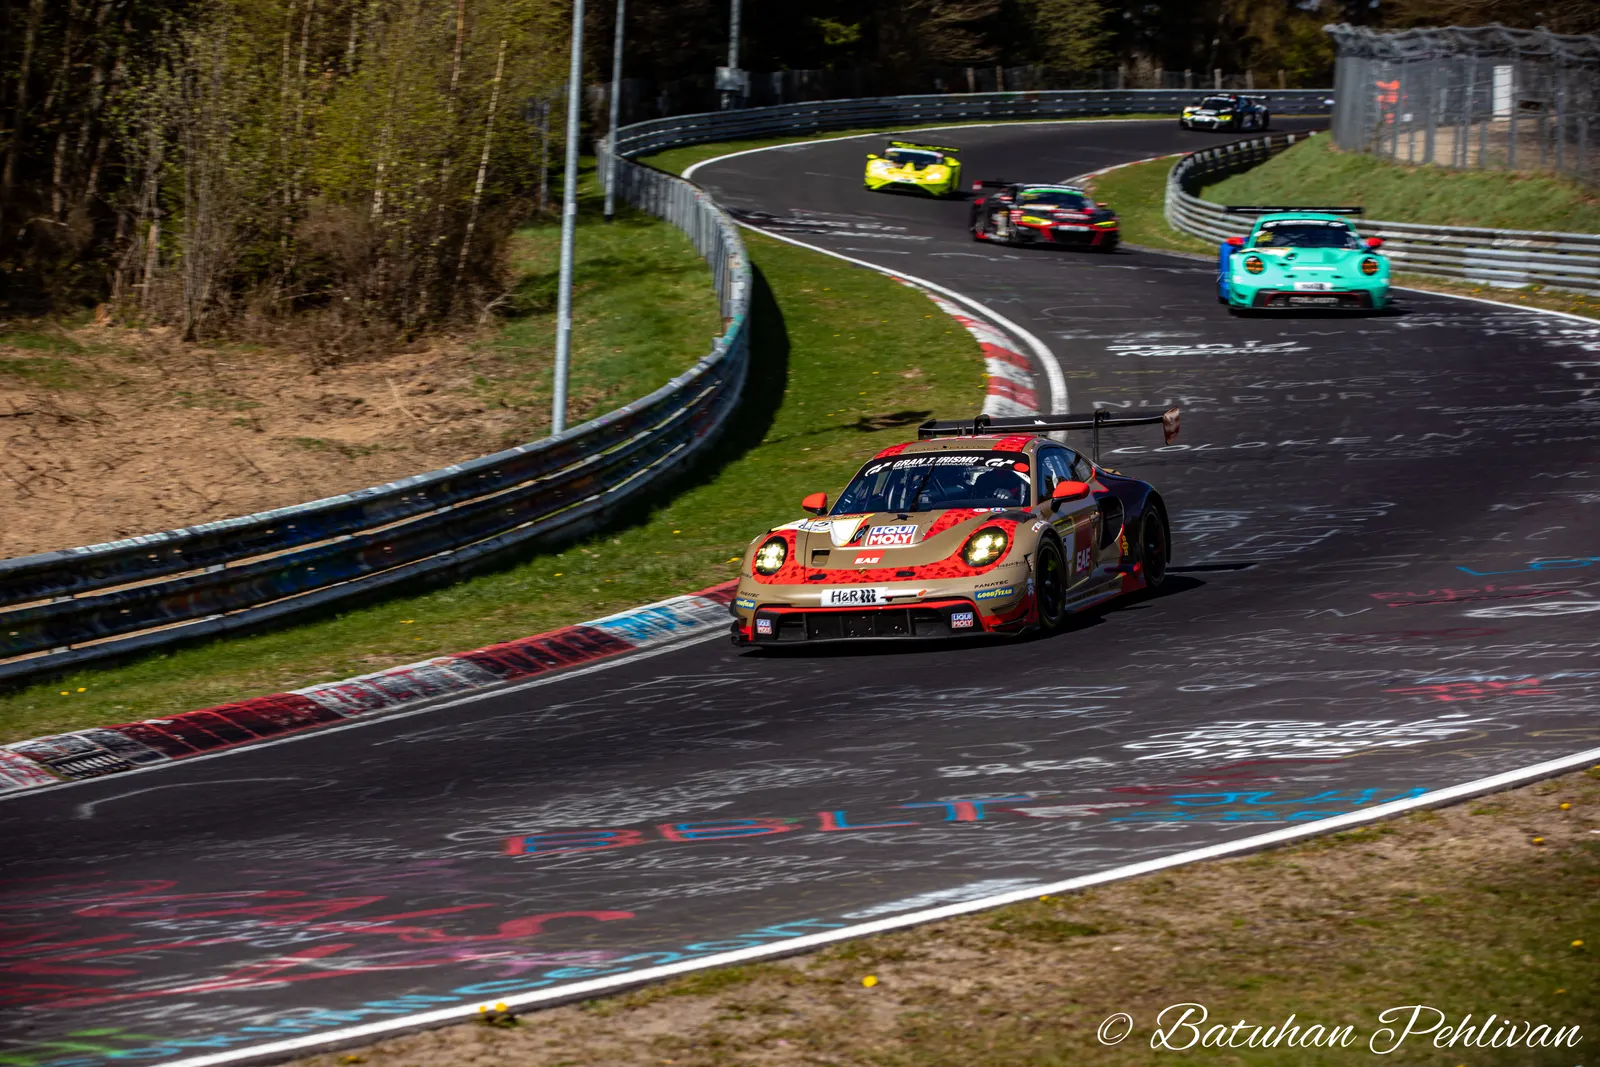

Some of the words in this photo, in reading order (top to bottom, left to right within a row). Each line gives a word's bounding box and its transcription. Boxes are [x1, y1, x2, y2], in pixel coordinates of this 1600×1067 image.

[893, 457, 927, 468] GRAN
[870, 526, 913, 535] LIQUI
[868, 534, 913, 545] MOLY
[1075, 546, 1091, 572] EAE
[974, 579, 1009, 589] FANATEC
[831, 590, 858, 603] H&R
[976, 588, 1013, 599] GOODYEAR
[952, 613, 973, 621] LIQUI
[953, 620, 973, 628] MOLY
